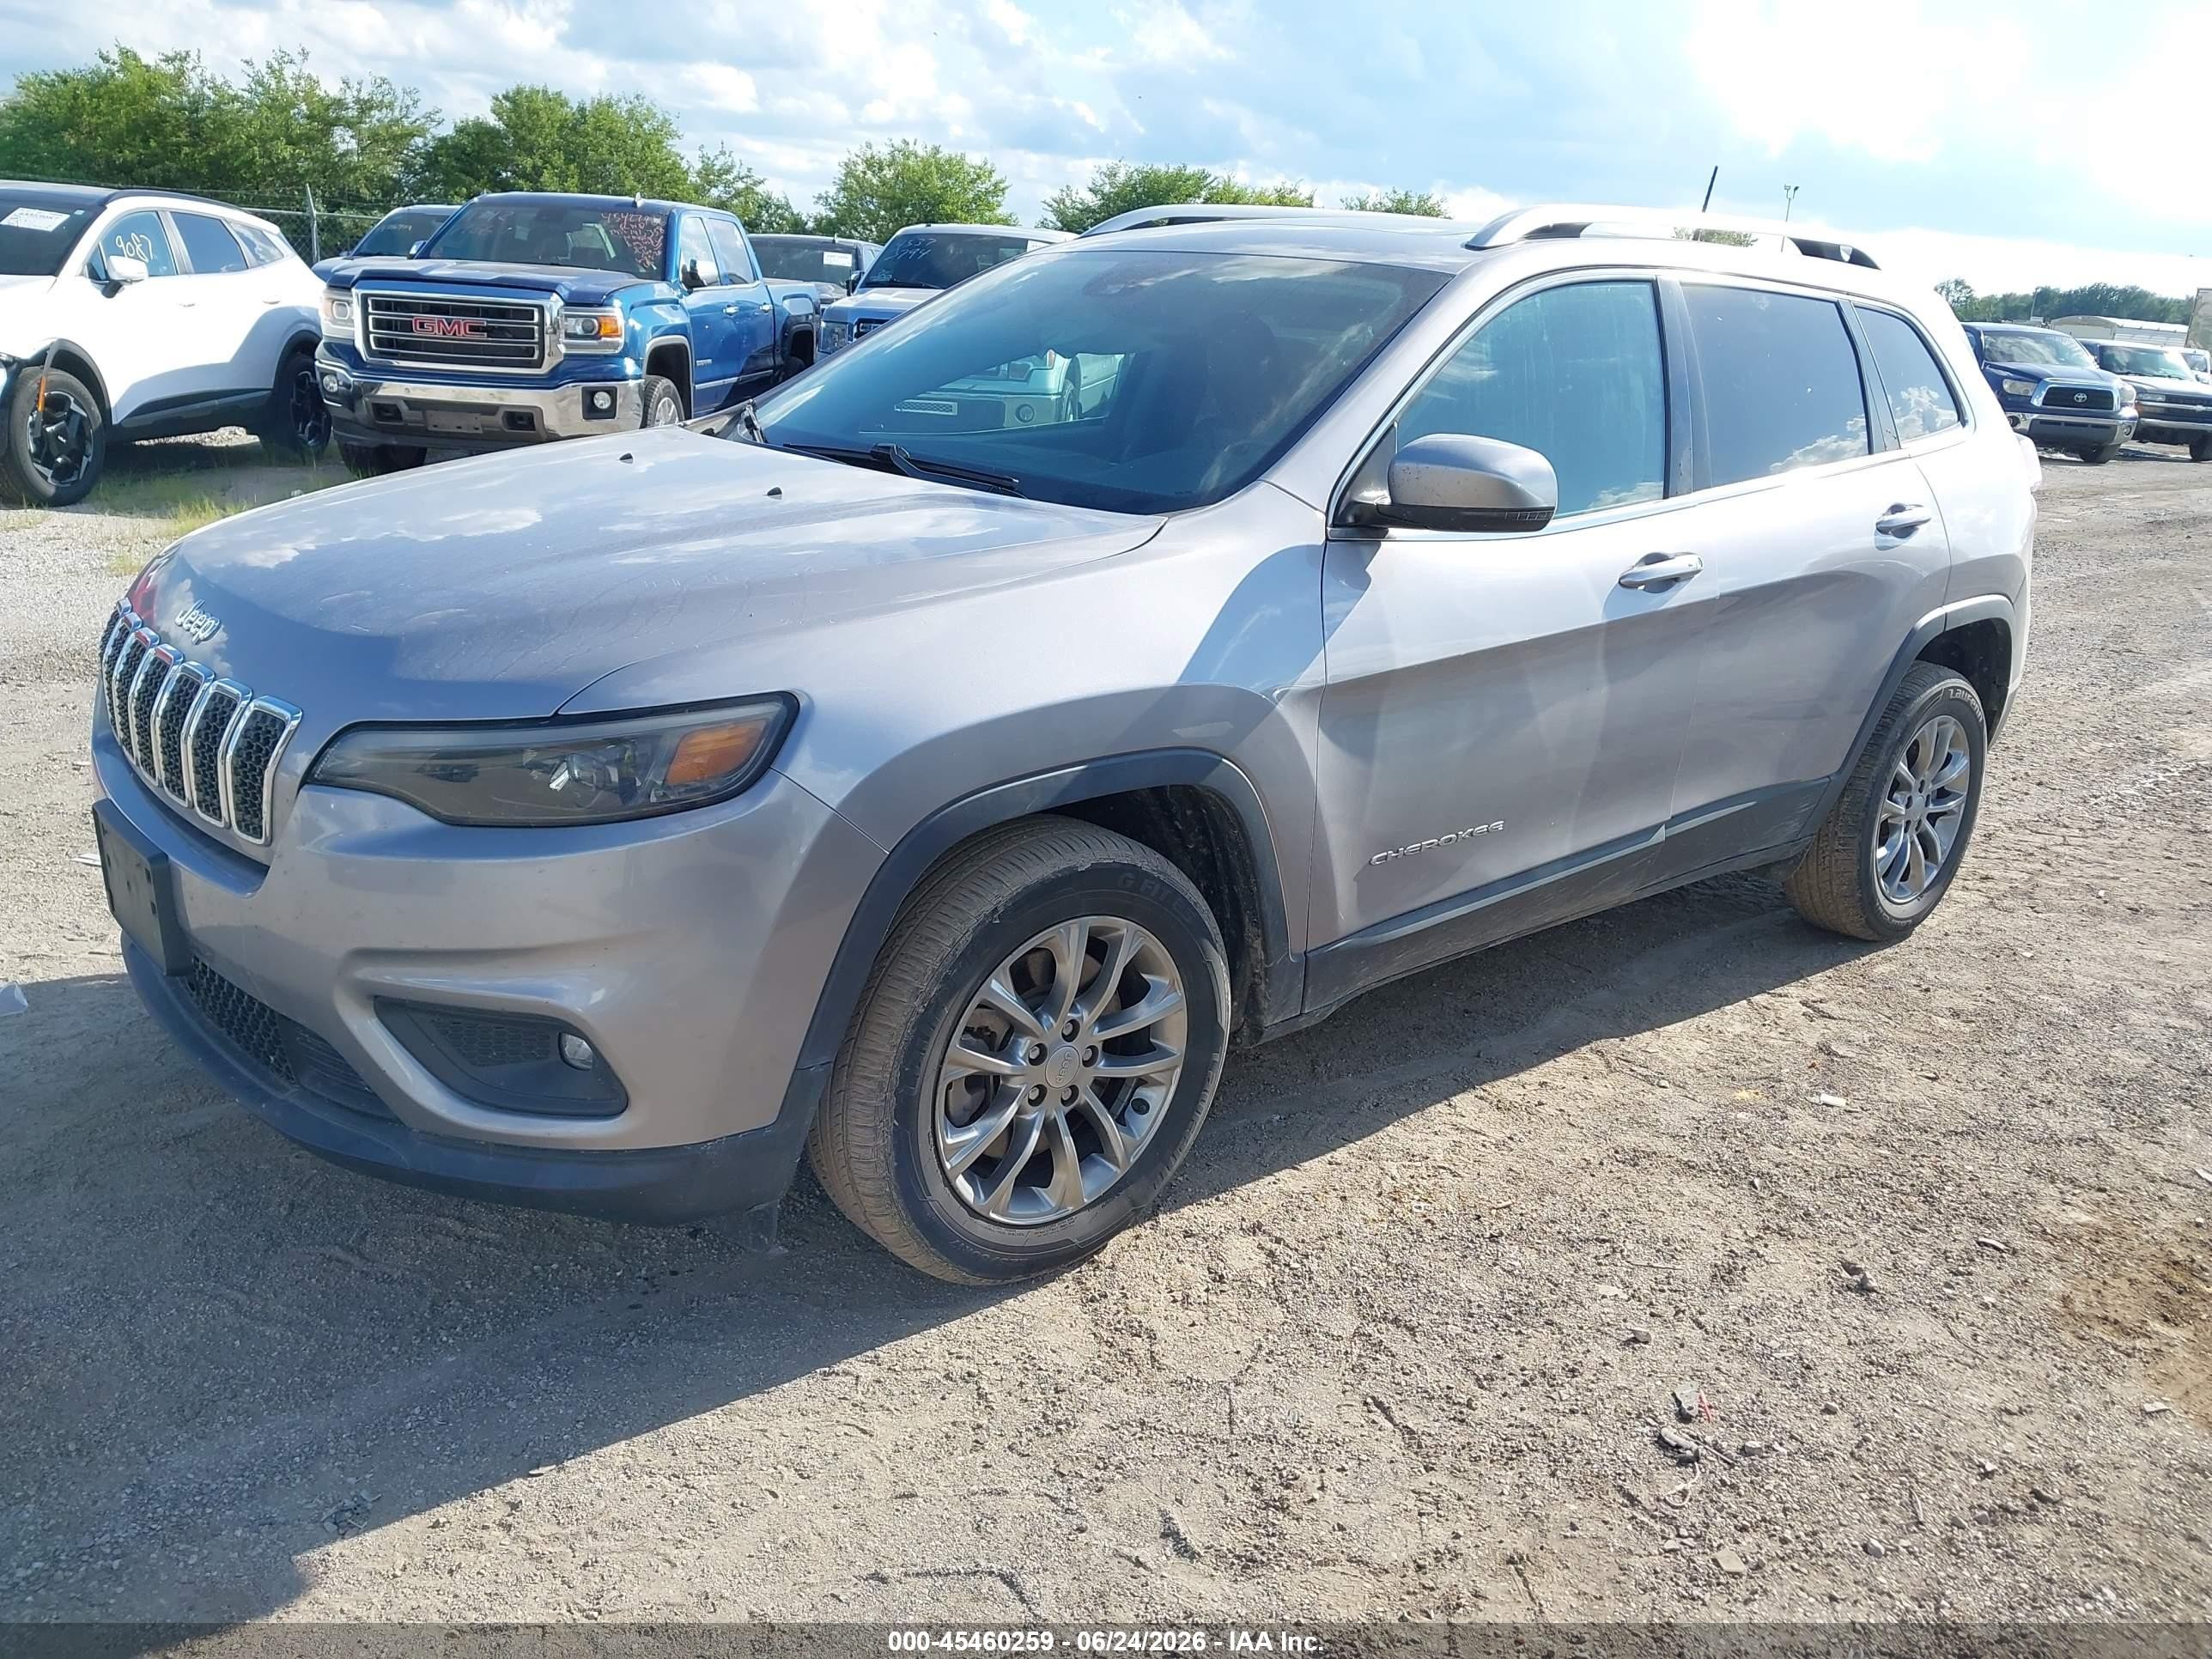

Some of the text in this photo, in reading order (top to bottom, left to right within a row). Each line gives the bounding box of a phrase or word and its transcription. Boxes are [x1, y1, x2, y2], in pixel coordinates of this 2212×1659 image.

[412, 316, 487, 337] GMC
[175, 599, 220, 644] Jeep
[1370, 820, 1505, 866] CHEROKEE
